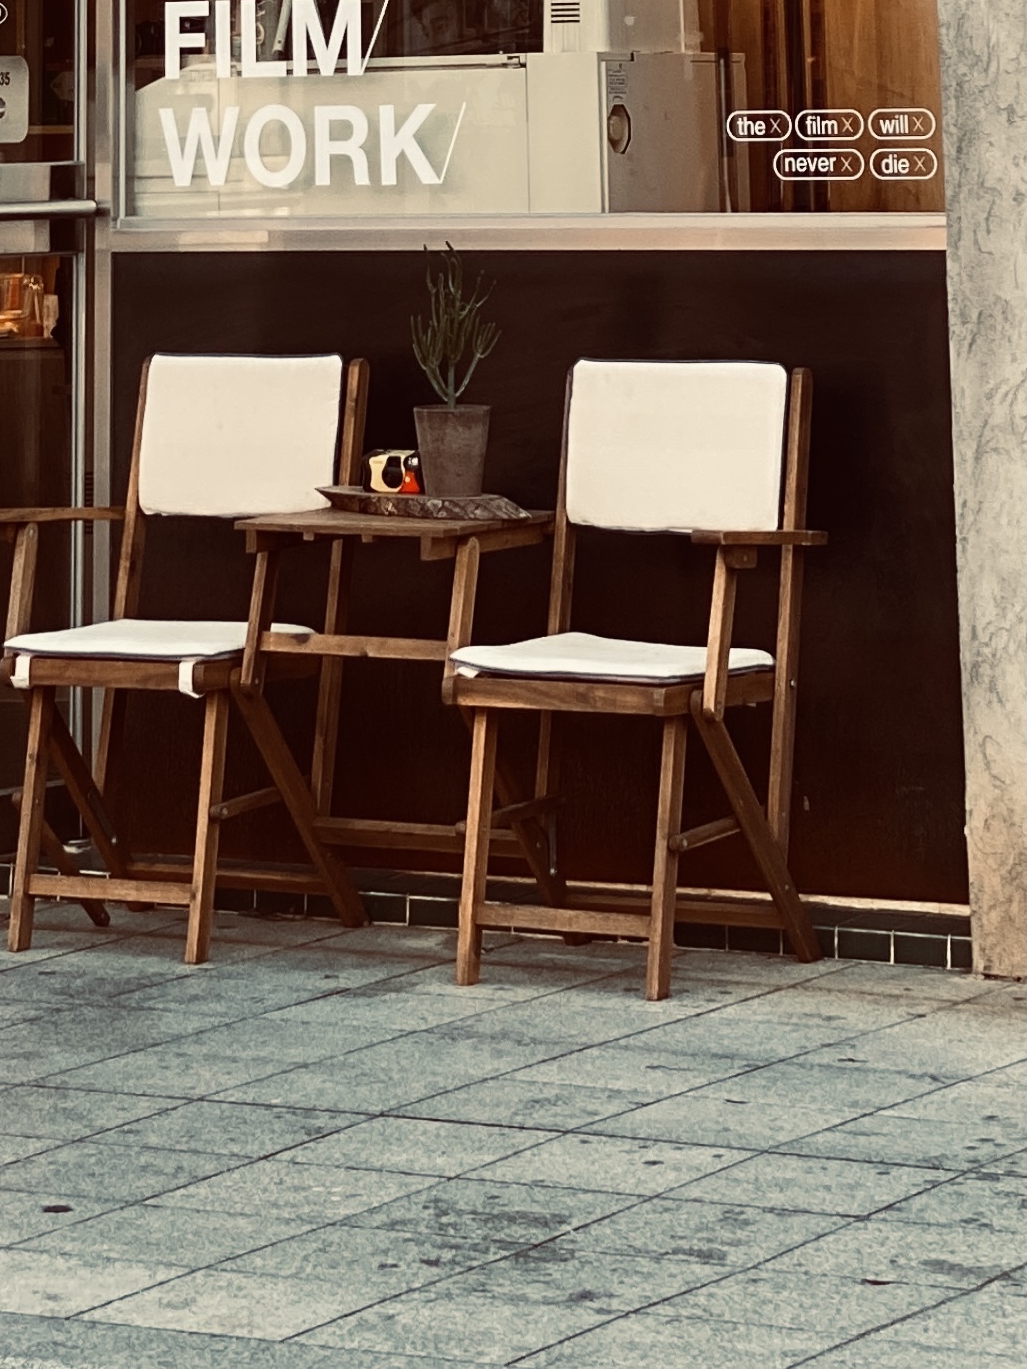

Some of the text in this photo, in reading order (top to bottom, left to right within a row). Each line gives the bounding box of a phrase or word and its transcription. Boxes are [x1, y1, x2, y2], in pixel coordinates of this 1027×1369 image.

[0, 71, 11, 86] 35
[736, 114, 909, 136] the film will
[784, 153, 910, 174] never die
